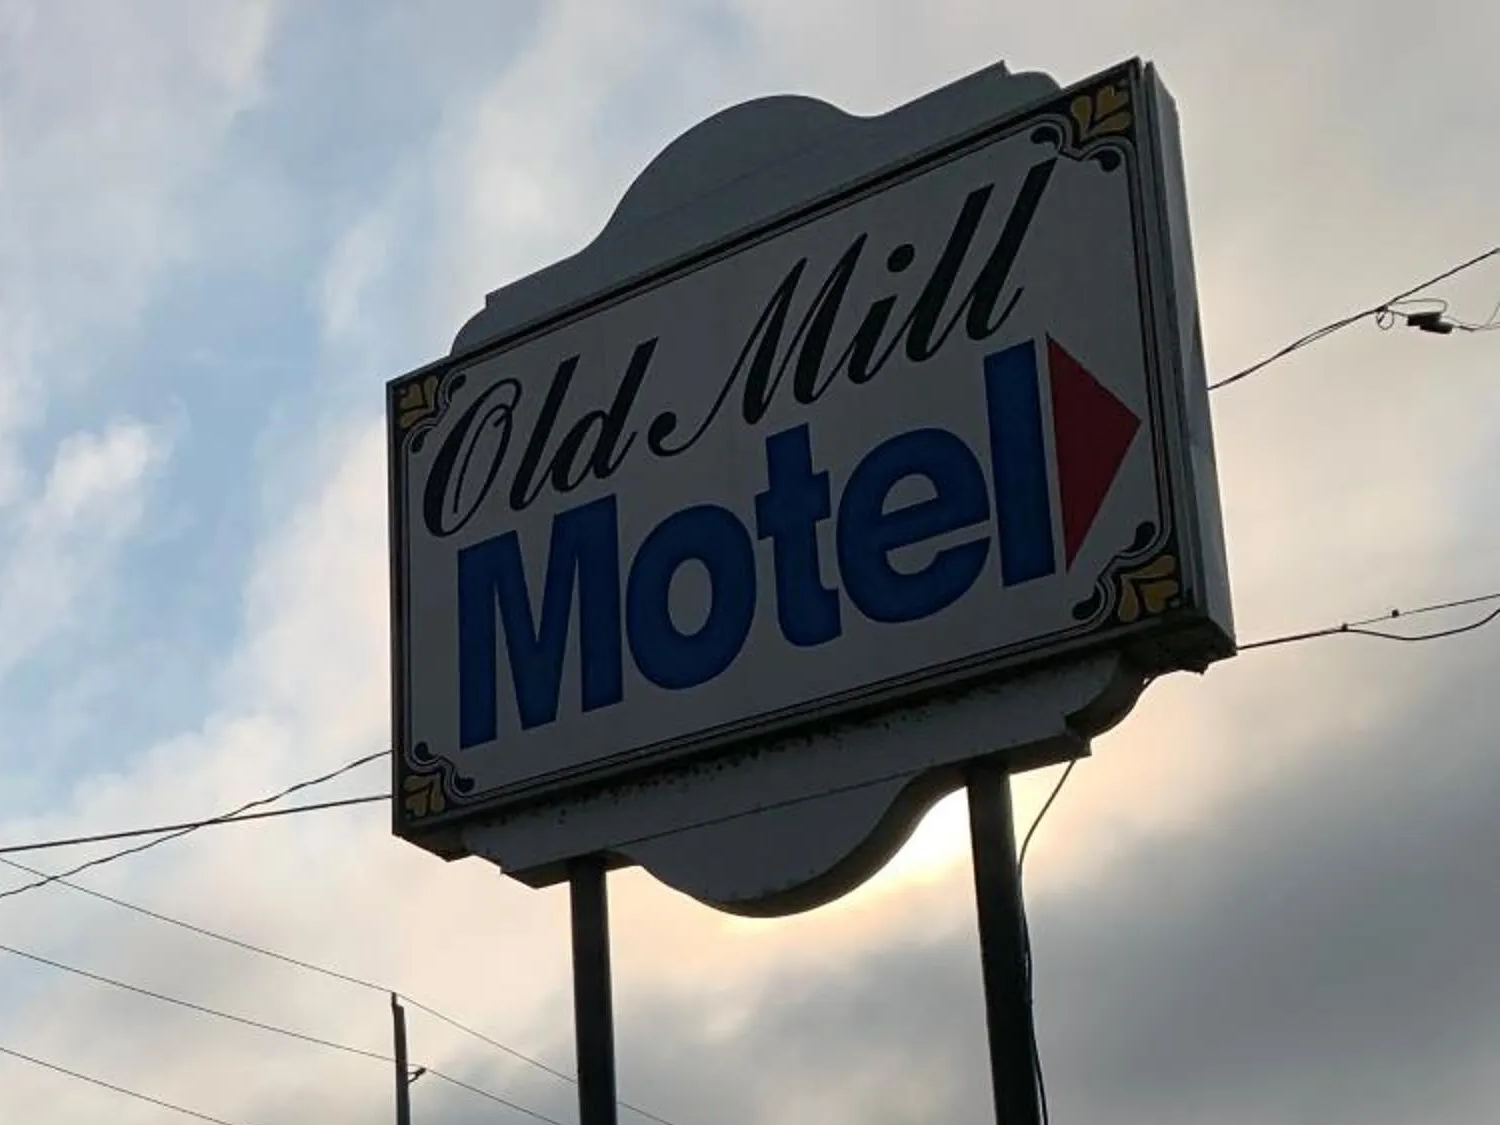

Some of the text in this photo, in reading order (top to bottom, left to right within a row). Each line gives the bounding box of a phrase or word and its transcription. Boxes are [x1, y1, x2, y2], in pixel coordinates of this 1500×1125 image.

[424, 157, 1057, 537] Old Mill
[457, 339, 1056, 751] Motel
